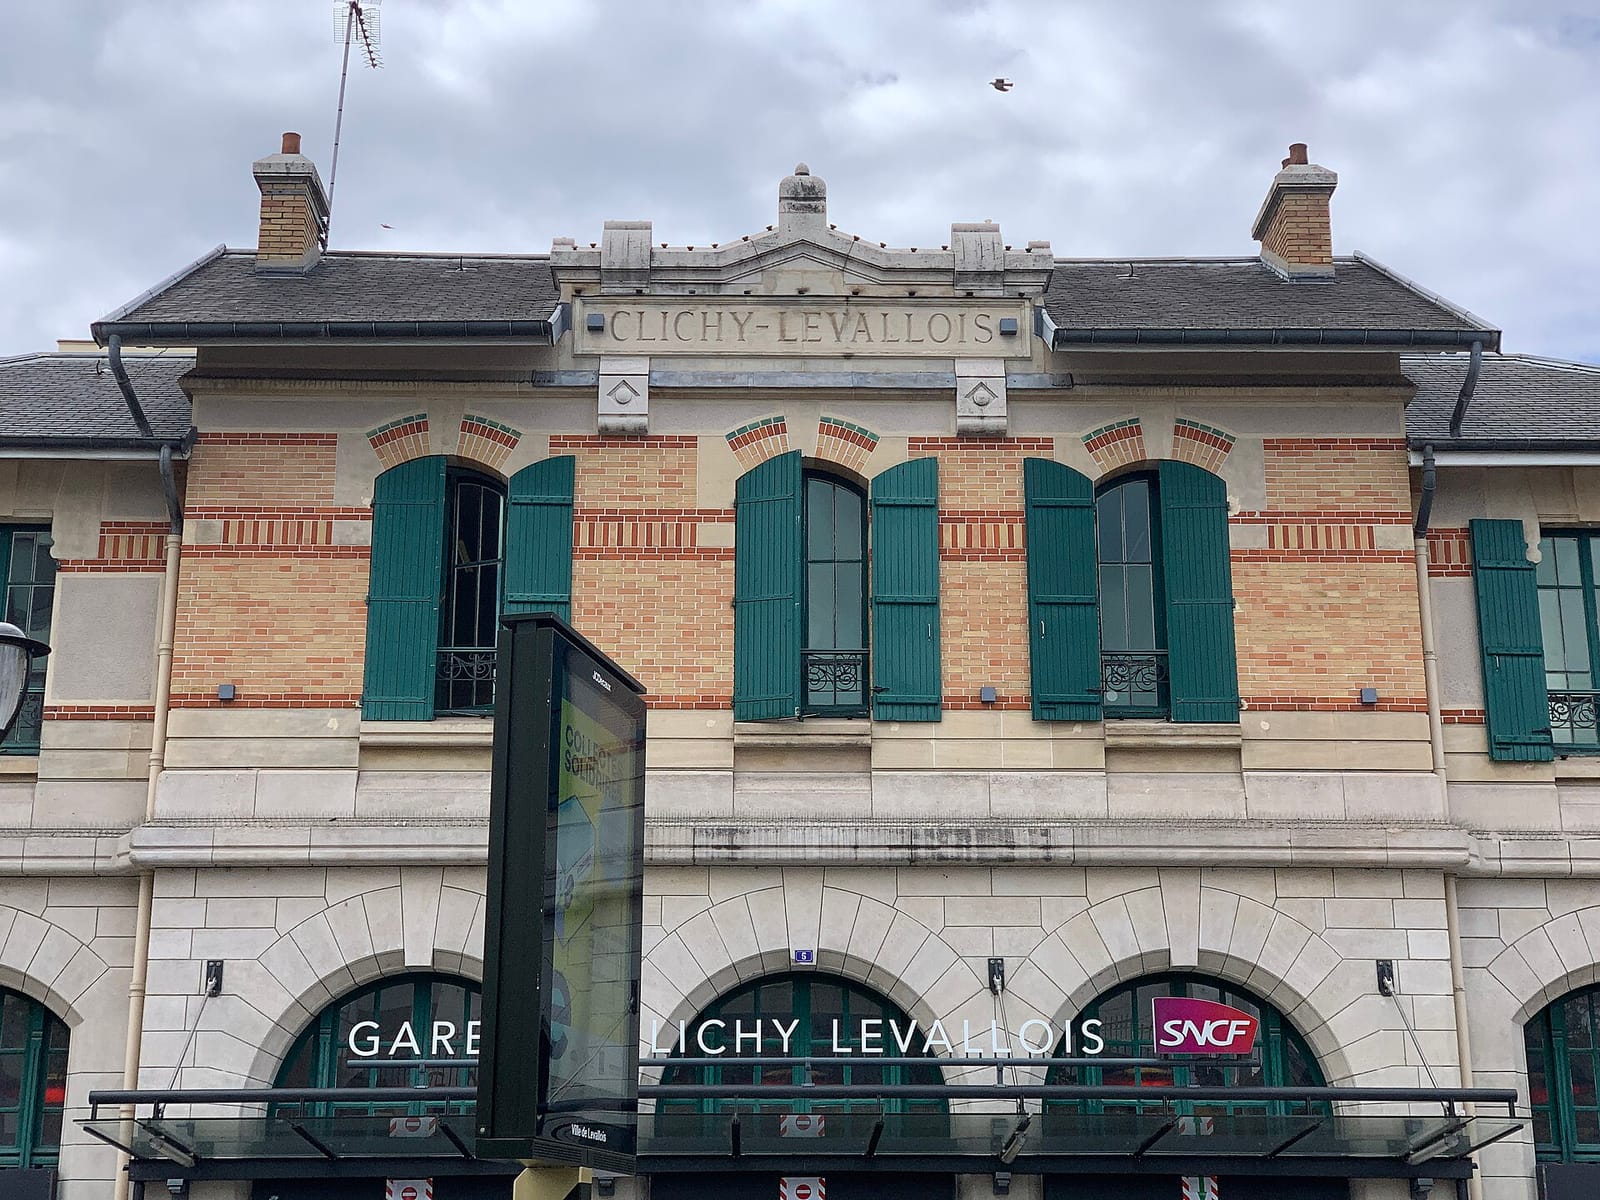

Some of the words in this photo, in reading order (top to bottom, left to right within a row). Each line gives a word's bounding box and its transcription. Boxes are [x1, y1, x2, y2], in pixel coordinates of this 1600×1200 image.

[609, 309, 994, 344] CLICHY-LEVALLOIS
[801, 952, 807, 960] 5
[348, 1020, 481, 1057] GARE
[651, 1018, 800, 1055] LICHY
[831, 1018, 1104, 1055] LEVALLOIS
[1159, 1019, 1251, 1047] SNCF
[571, 1123, 581, 1136] Ville
[582, 1126, 587, 1138] de
[588, 1127, 607, 1143] Levallois
